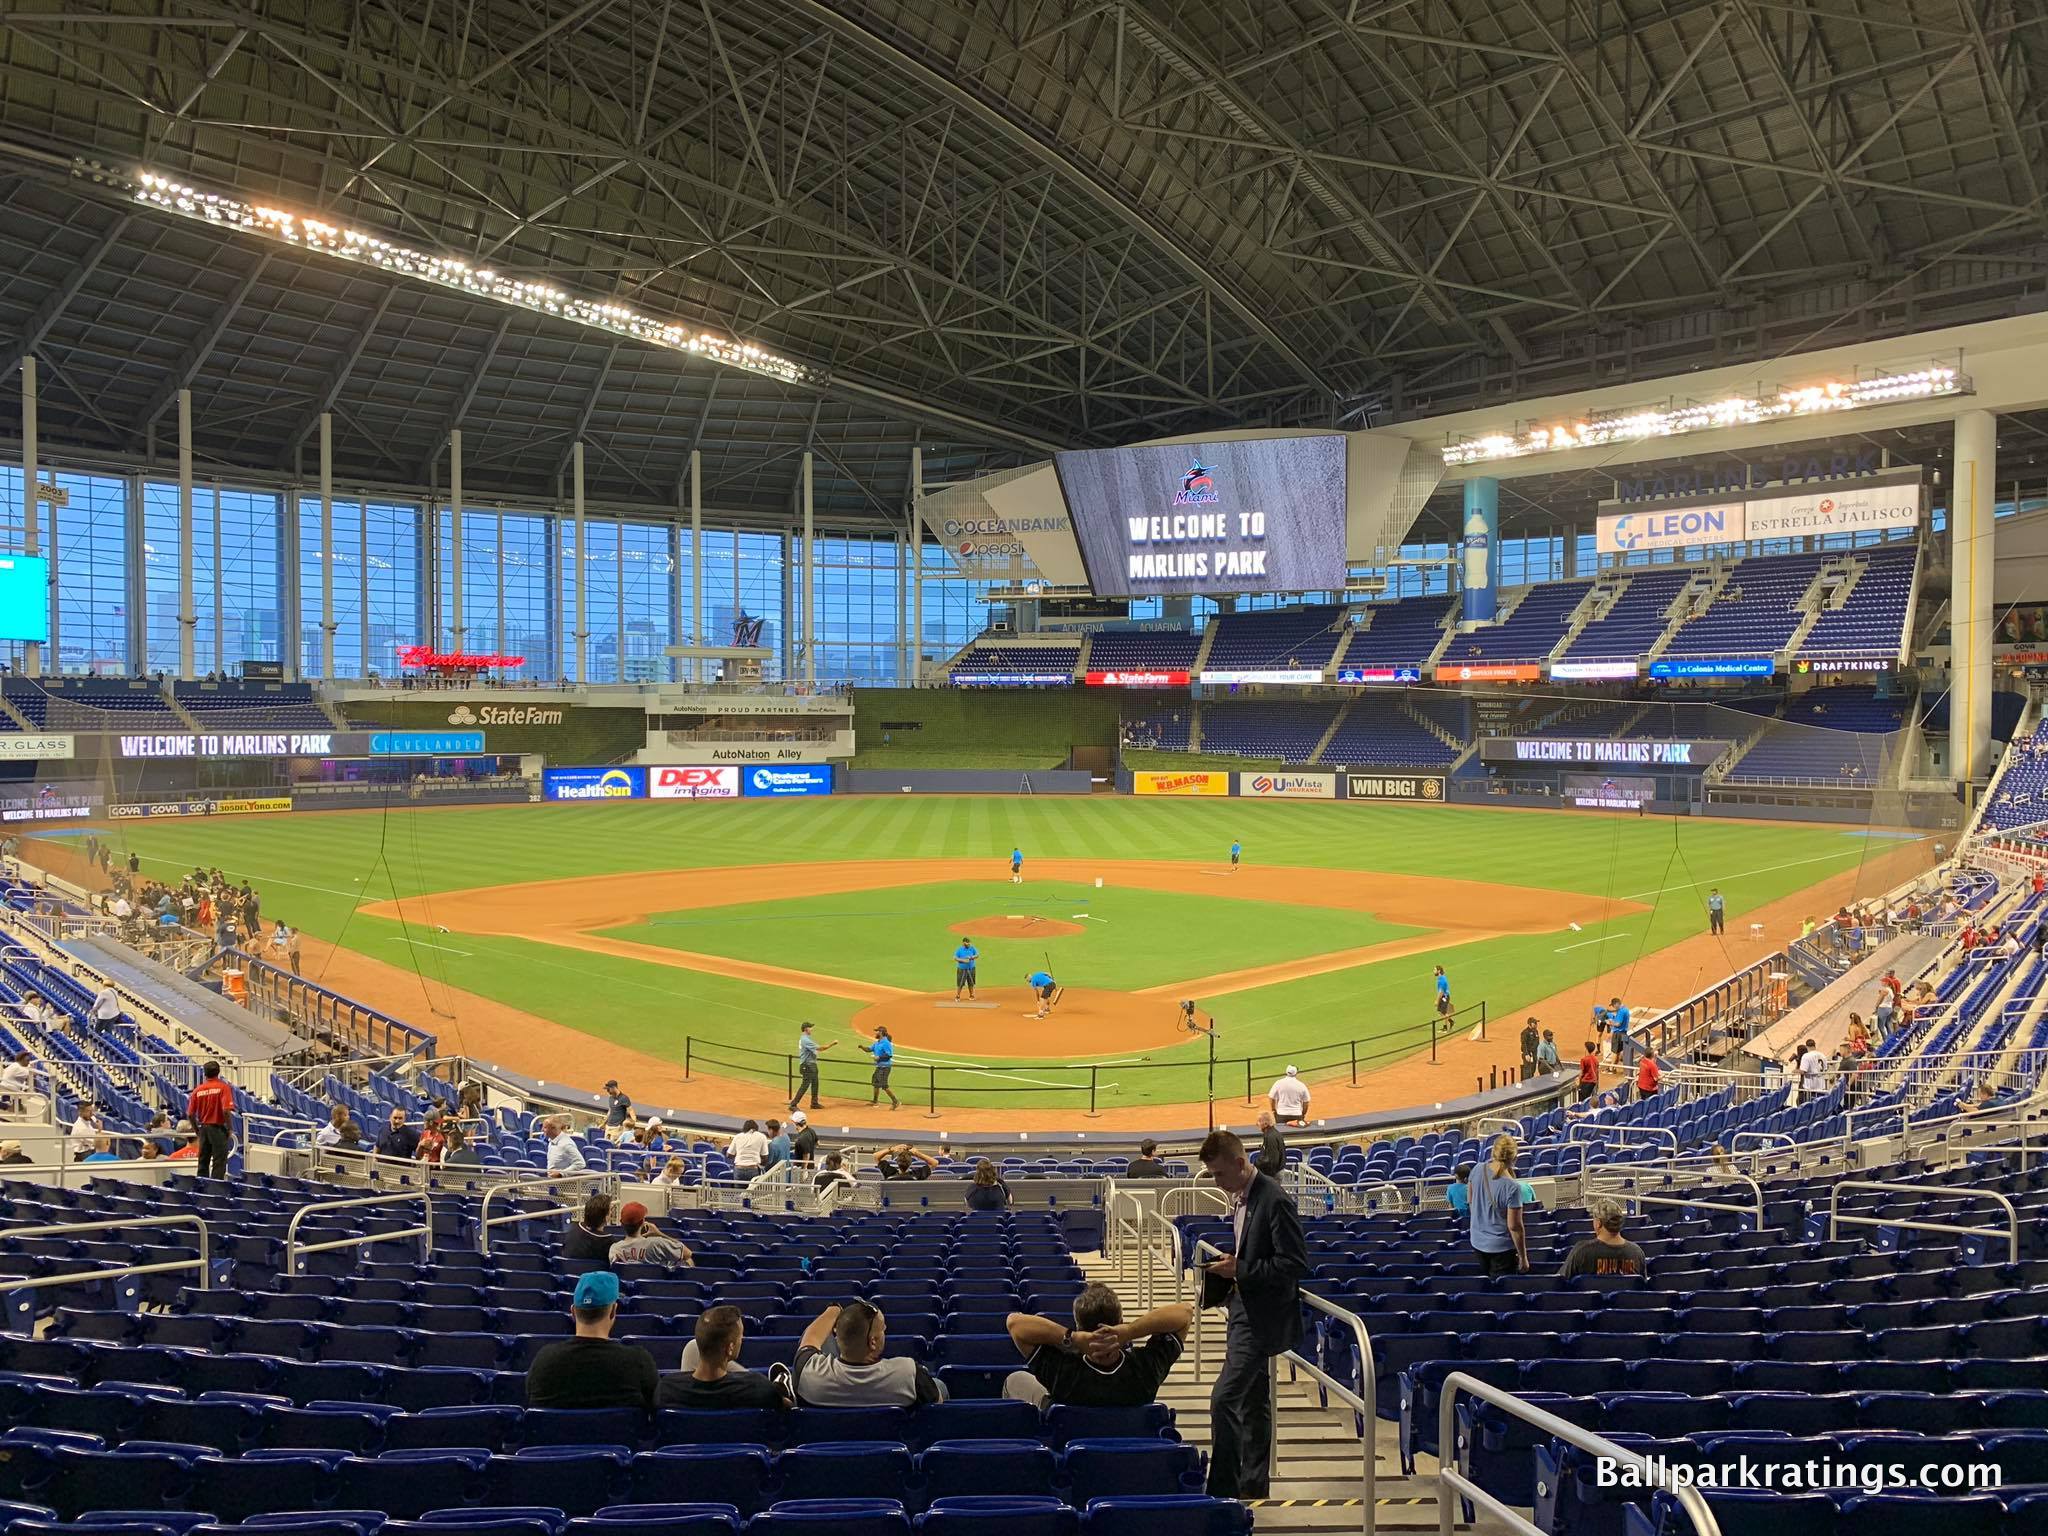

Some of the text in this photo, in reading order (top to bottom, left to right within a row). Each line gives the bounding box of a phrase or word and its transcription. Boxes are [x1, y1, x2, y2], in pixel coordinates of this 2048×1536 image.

[1620, 450, 1877, 502] MARLINS PARK
[40, 484, 63, 496] 2003
[1173, 490, 1218, 508] Miami
[964, 518, 1067, 534] OCEANBANK
[1647, 511, 1725, 537] LEON
[1751, 506, 1914, 531] ESTRELLA JALISCO
[1129, 512, 1266, 542] WELCOME TO
[976, 541, 1023, 556] pepsi
[1129, 551, 1267, 580] MARLINS PARK
[1813, 661, 1889, 671] DRAFTKINGS
[479, 706, 562, 725] StateFarm
[15, 741, 67, 750] GLASS
[120, 734, 333, 757] WELCOME TO MARLINS PARK
[1516, 741, 1691, 763] WELCOME TO MARLINS PARK
[712, 749, 802, 760] AutoNation Alley
[658, 769, 725, 786] DEX
[1274, 778, 1322, 791] UniVista
[558, 784, 631, 798] HealthSun
[674, 786, 731, 795] imaging
[1353, 779, 1415, 796] WIN BIG!
[112, 807, 140, 815] GOYA
[151, 806, 179, 814] GOYA
